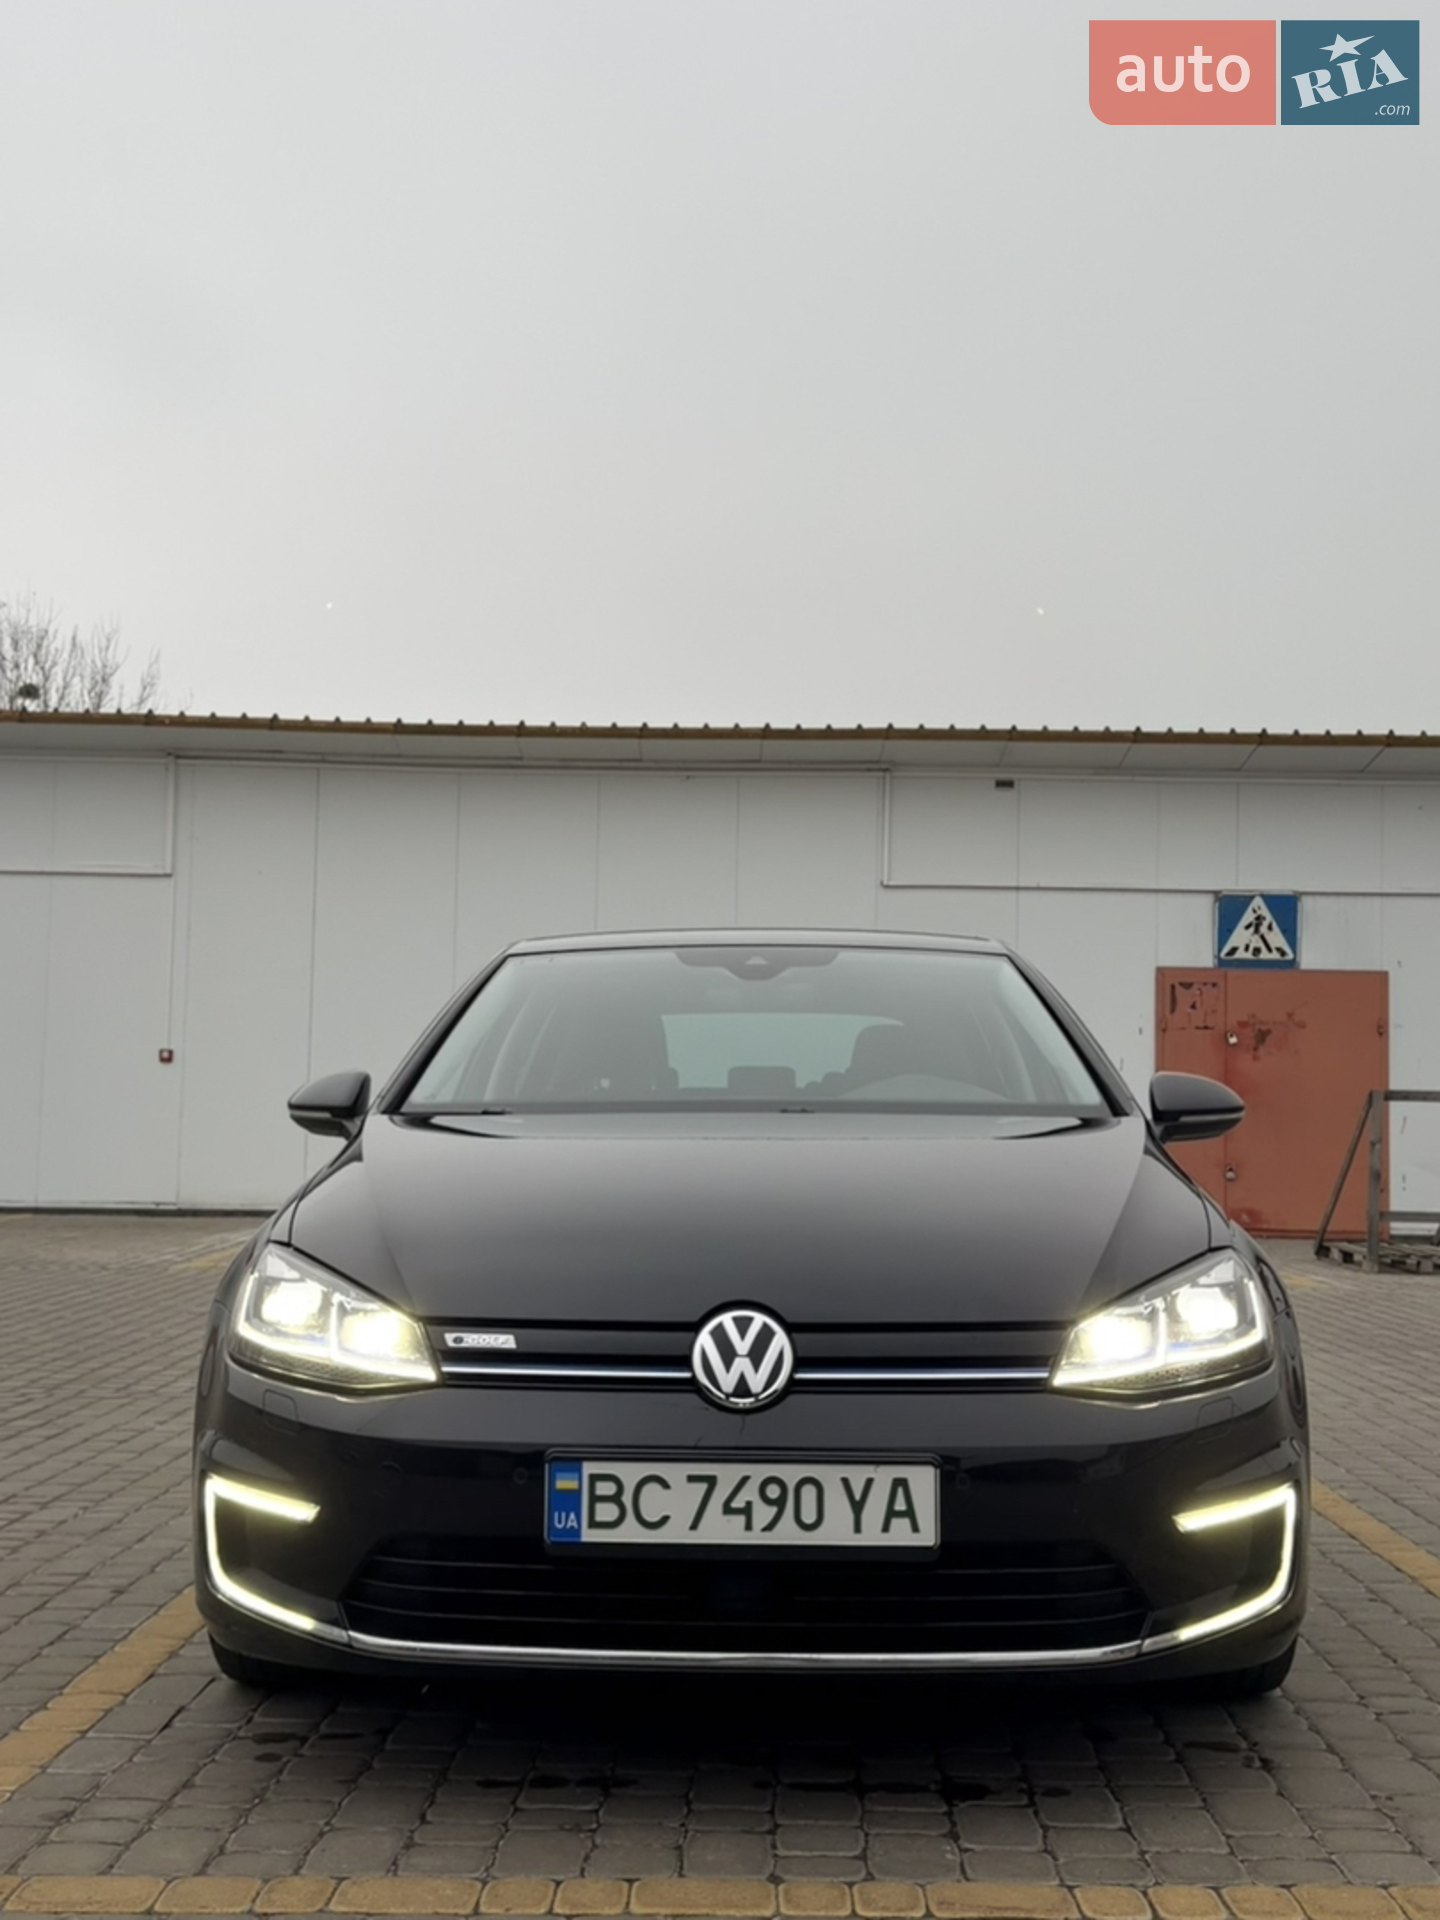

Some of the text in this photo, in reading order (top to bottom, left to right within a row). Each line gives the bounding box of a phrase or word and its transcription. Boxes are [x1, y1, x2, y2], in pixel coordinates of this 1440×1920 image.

[553, 1511, 579, 1529] UA
[587, 1473, 920, 1534] BC 7490 YA
